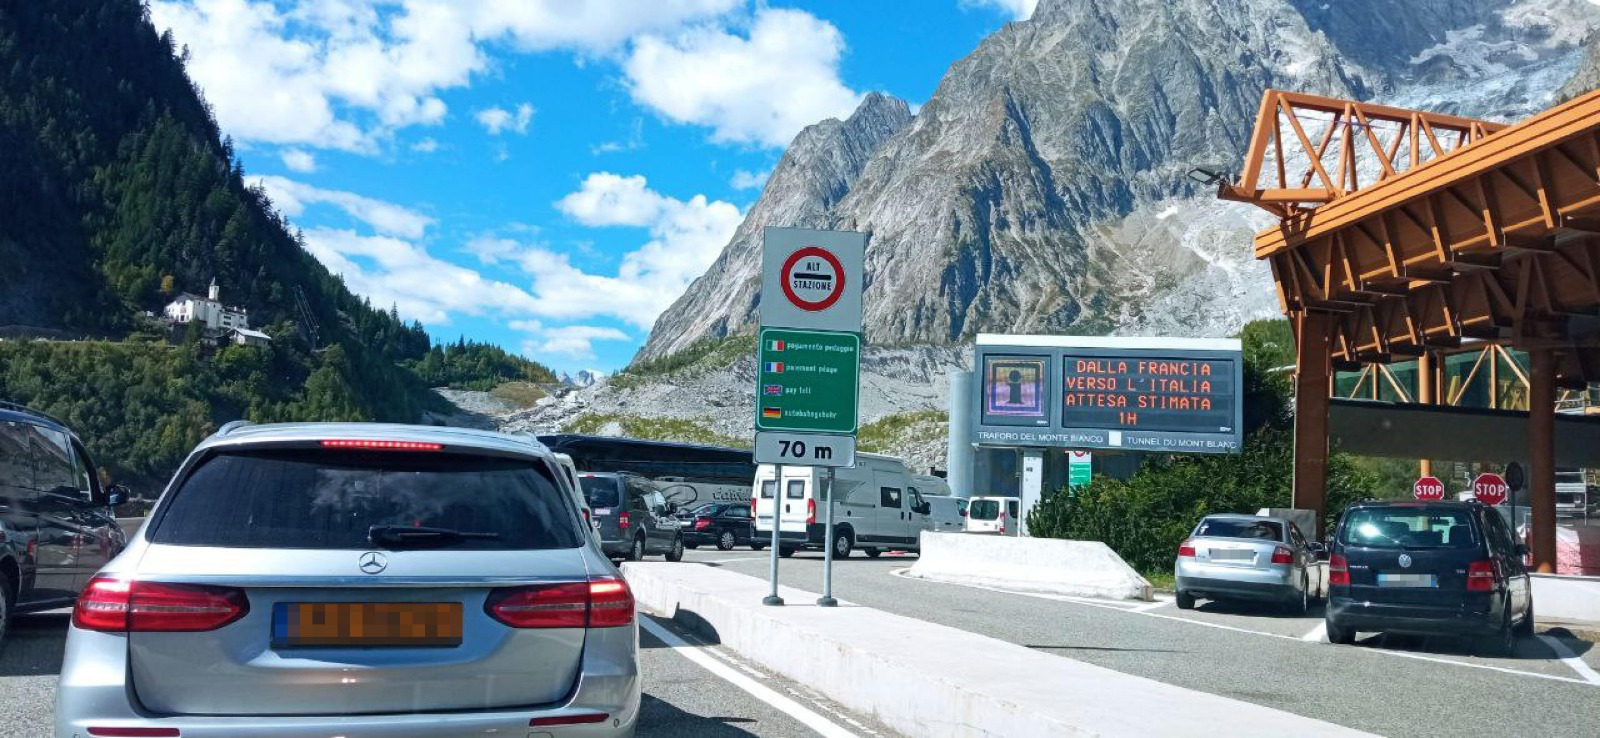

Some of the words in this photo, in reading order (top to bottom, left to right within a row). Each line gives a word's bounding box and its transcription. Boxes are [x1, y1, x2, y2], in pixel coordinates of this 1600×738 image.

[806, 262, 820, 271] ALT
[794, 281, 831, 290] STAZIONE
[1077, 360, 1127, 374] DALLA
[1139, 361, 1211, 376] FRANCIA
[1066, 377, 1117, 391] VERSO
[785, 387, 797, 395] pay
[1066, 394, 1127, 408] ATTESA
[1139, 395, 1211, 410] STIMATA
[1120, 412, 1137, 426] 1H
[978, 431, 1019, 440] TRAFORO
[1021, 432, 1036, 440] DEL
[1038, 434, 1068, 442] MONTE
[1070, 435, 1104, 443] BIANCO
[1127, 436, 1161, 446] TUNNEL
[1163, 439, 1177, 447] DU
[1178, 440, 1204, 448] MONT
[1206, 440, 1237, 449] BLANC
[779, 440, 806, 458] 70
[814, 446, 832, 459] m
[1415, 485, 1442, 495] STOP
[1475, 483, 1505, 497] STOP
